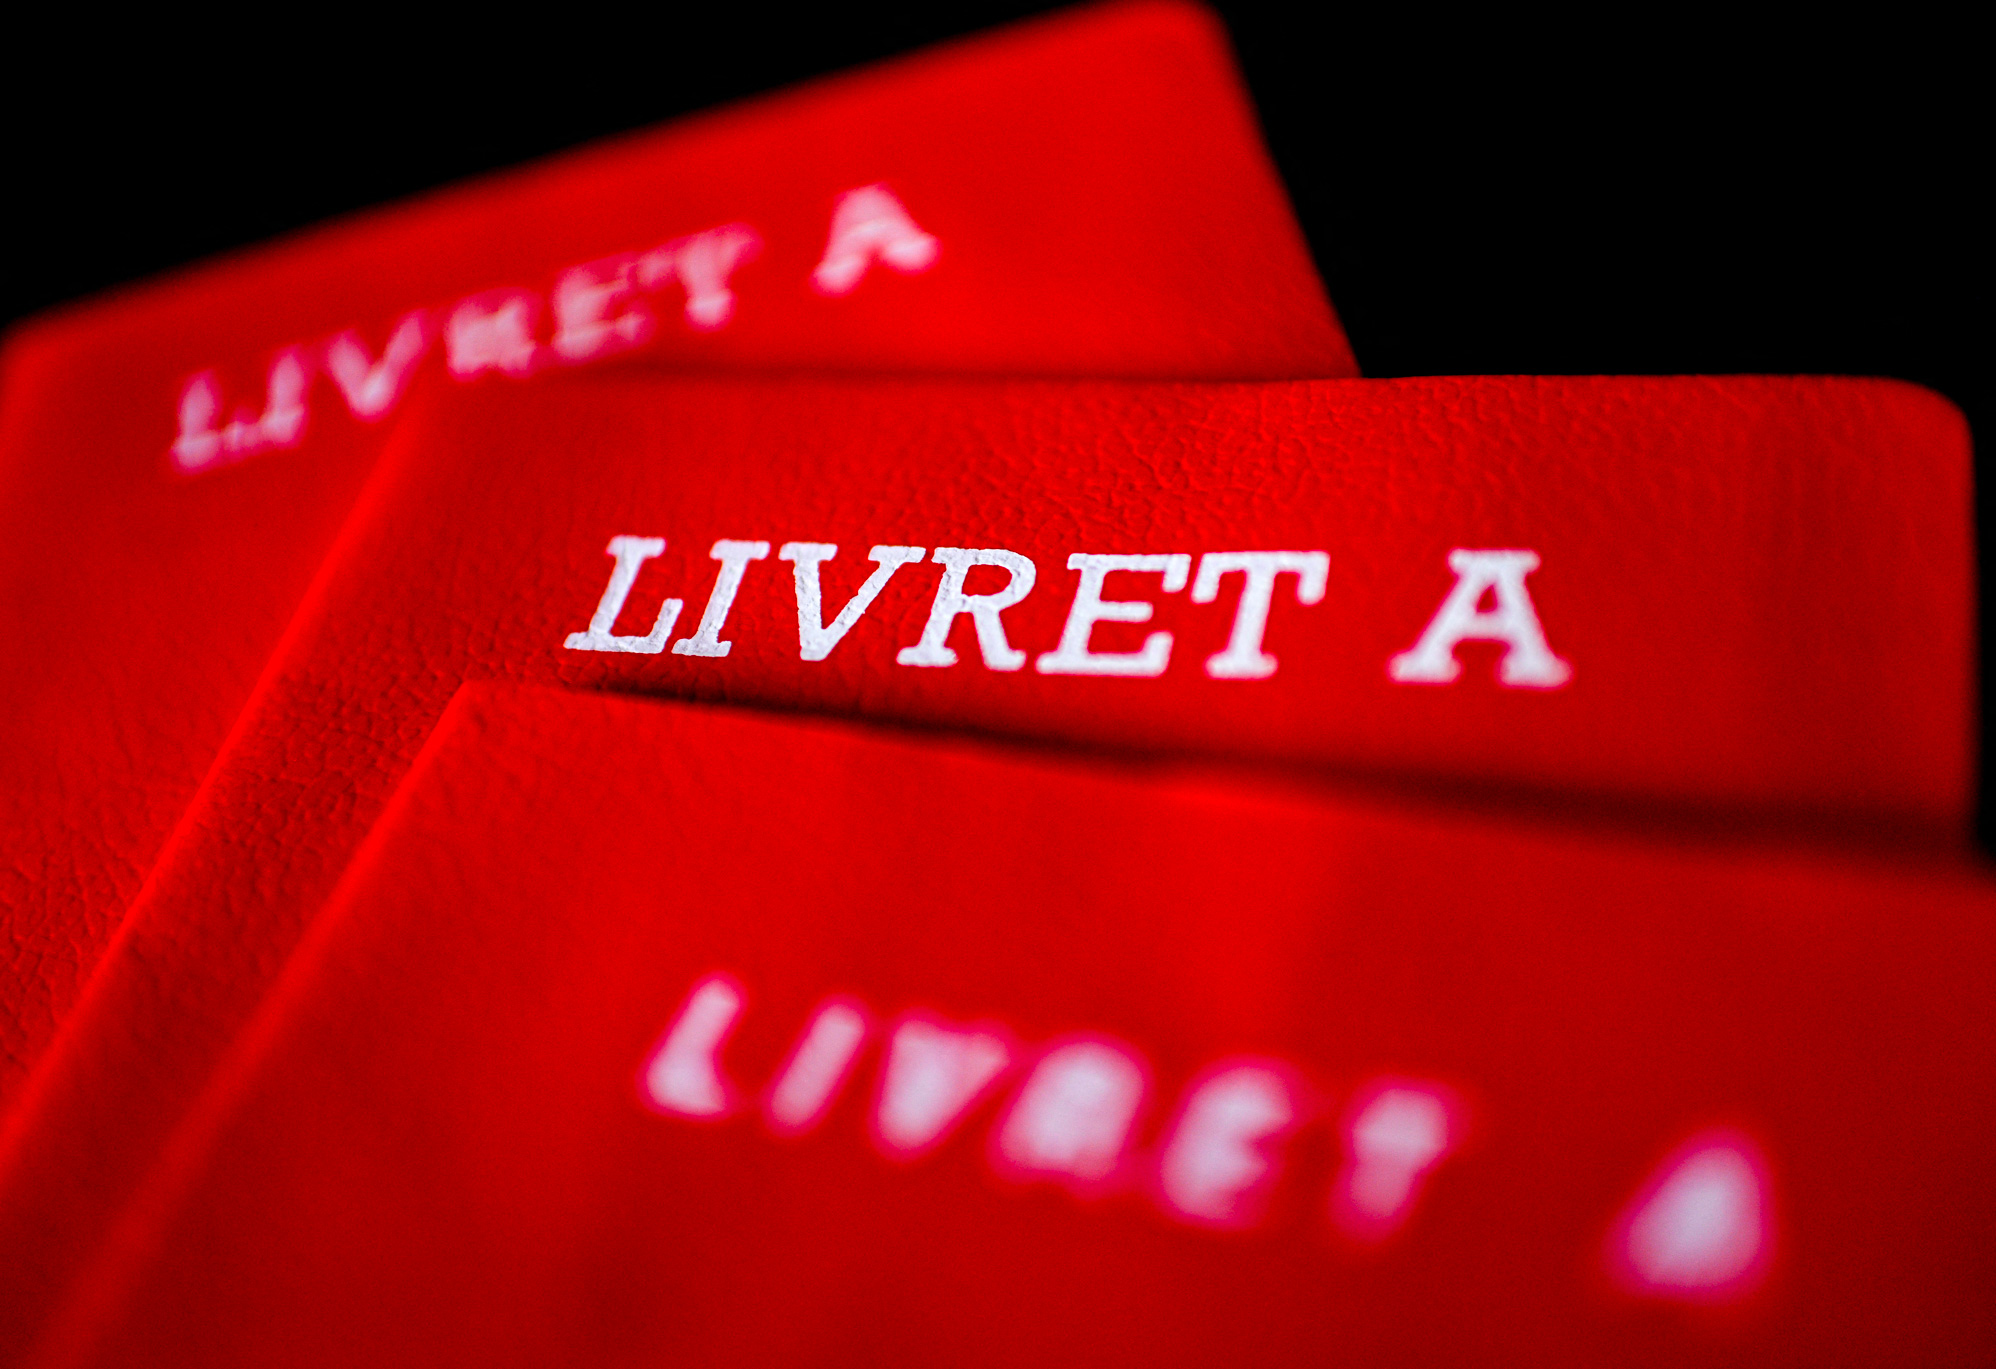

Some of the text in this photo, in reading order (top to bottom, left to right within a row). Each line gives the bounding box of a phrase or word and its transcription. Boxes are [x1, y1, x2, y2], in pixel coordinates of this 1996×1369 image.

[172, 186, 937, 470] LIVRET A
[564, 535, 1571, 689] LIVRET A
[641, 973, 1771, 1295] LIVRET A
